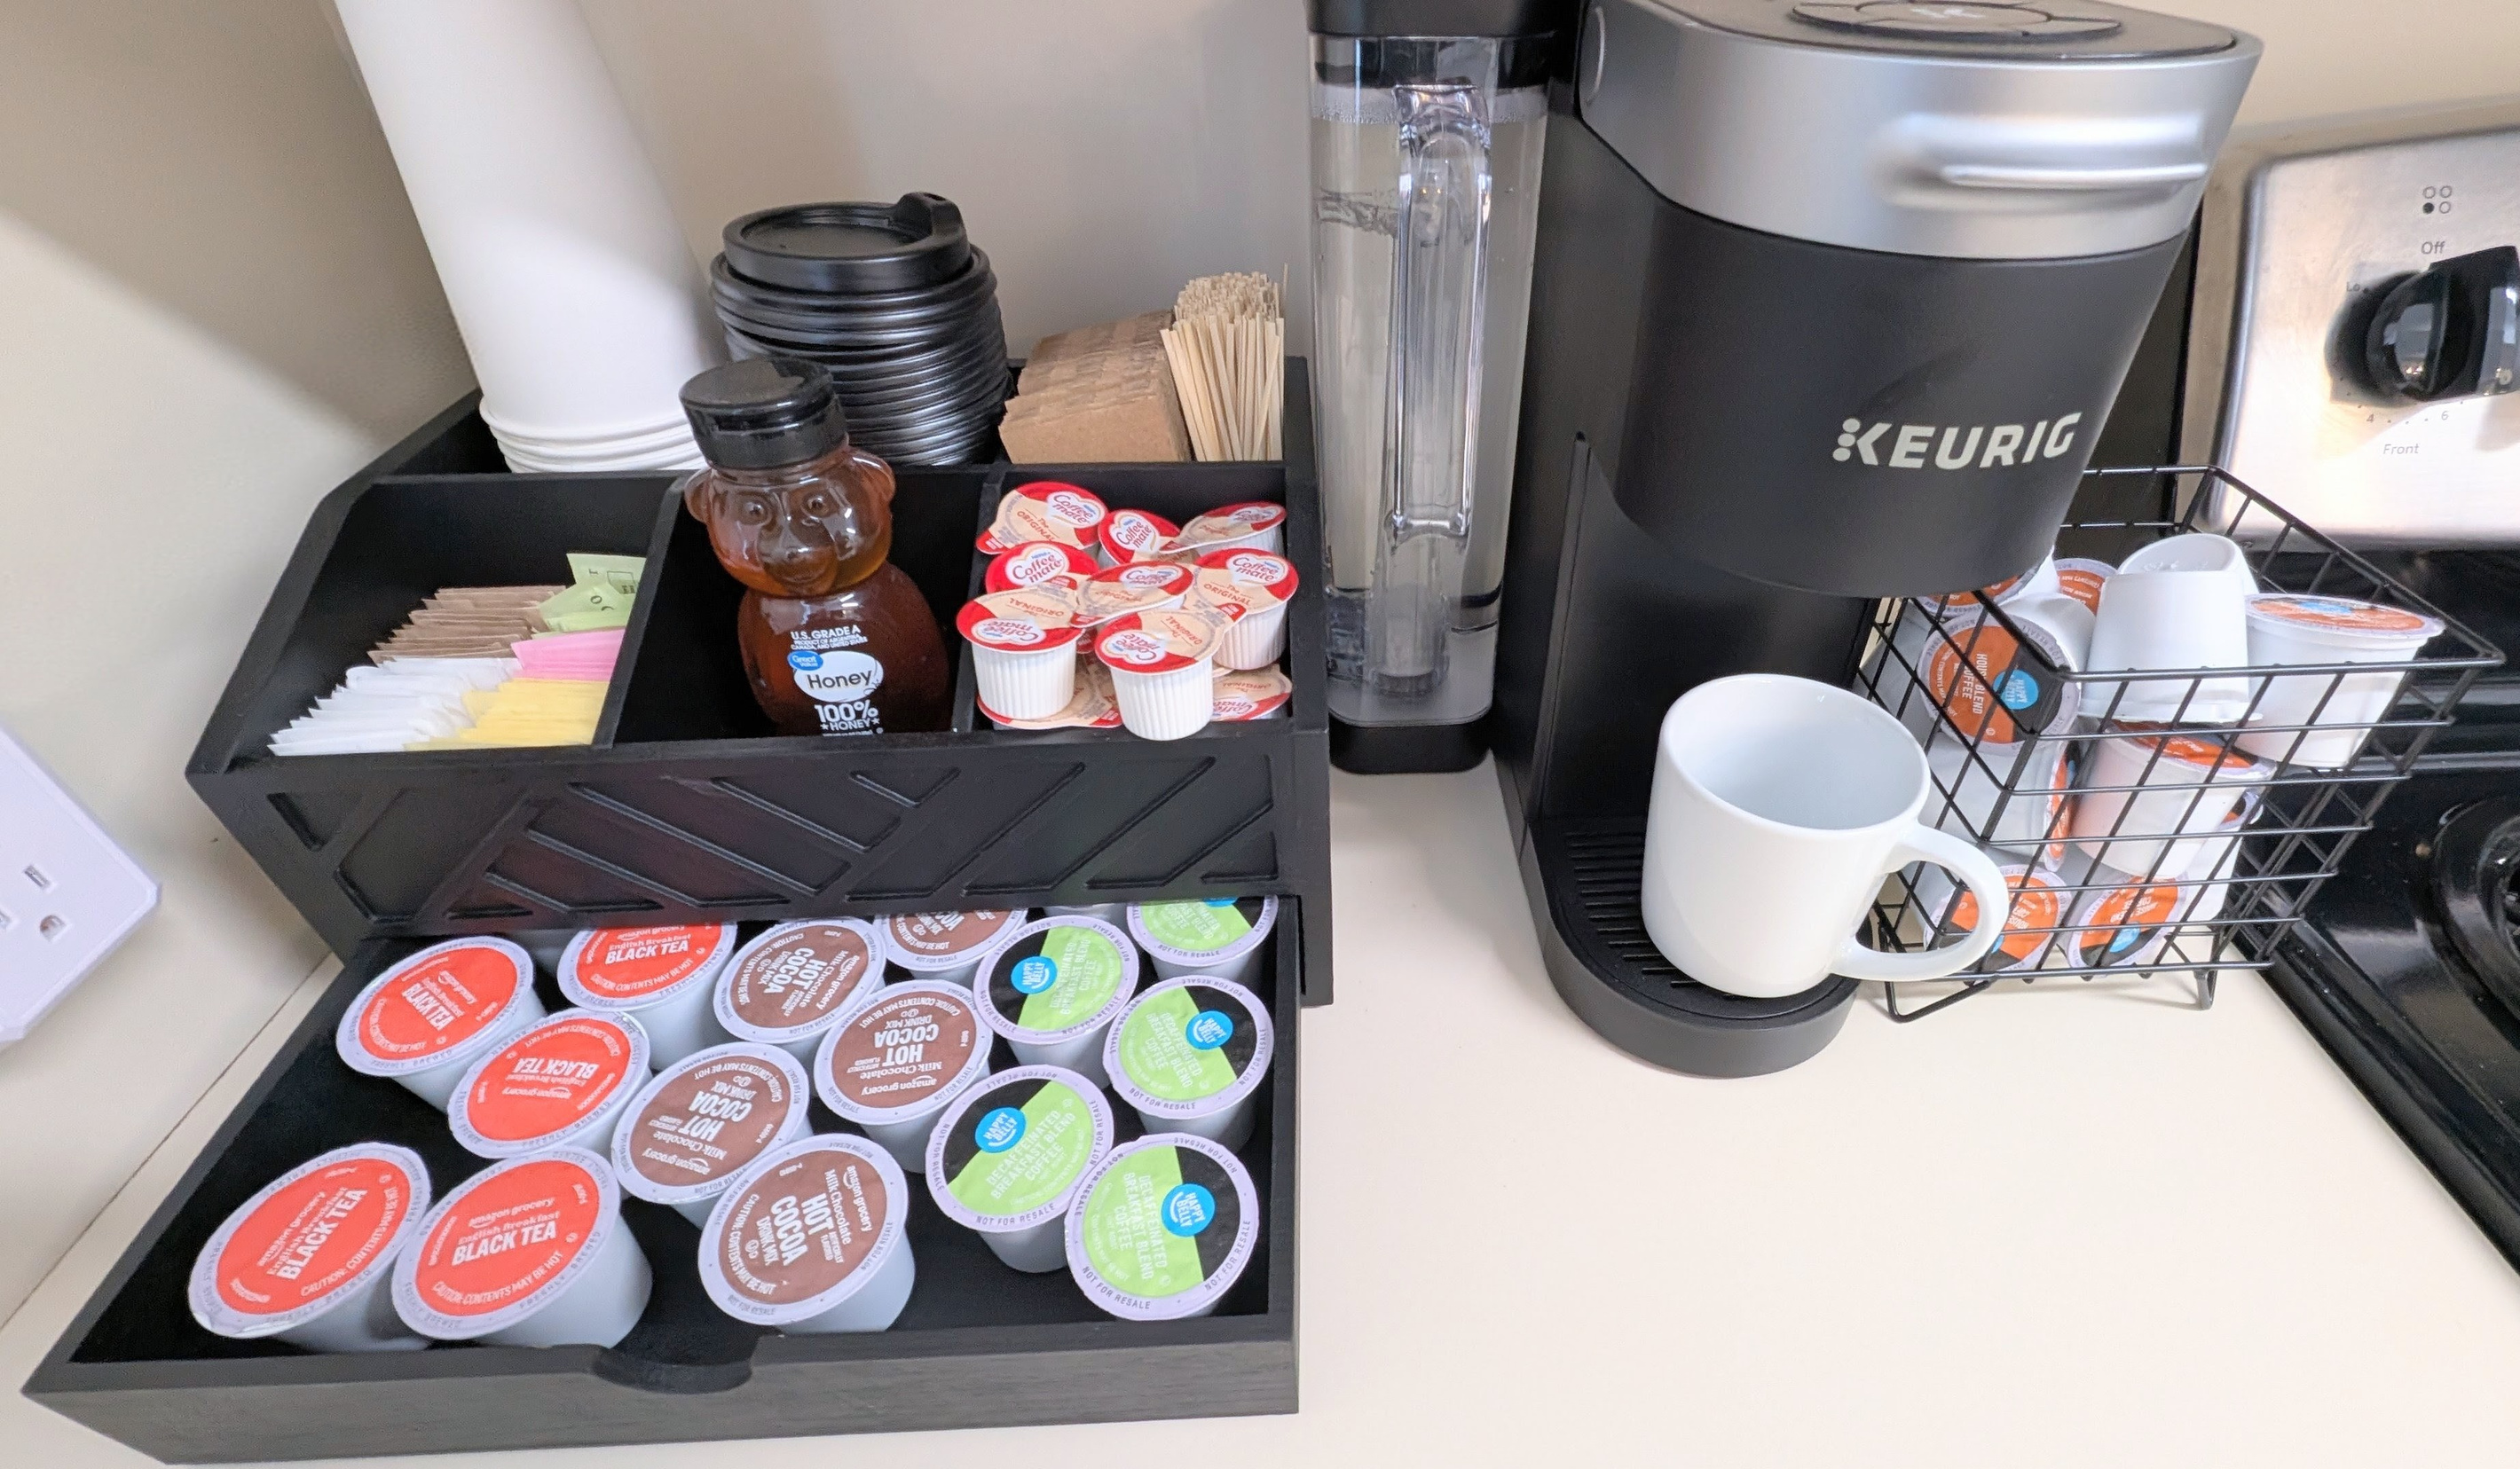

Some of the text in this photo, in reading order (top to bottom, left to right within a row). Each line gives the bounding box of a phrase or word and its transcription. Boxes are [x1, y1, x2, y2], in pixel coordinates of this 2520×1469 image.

[2421, 241, 2445, 255] Off
[2366, 411, 2449, 423] 4 6
[1832, 412, 2083, 469] KEURIG
[2382, 444, 2419, 455] Front
[1052, 504, 1087, 524] mate
[1053, 494, 1093, 519] Coffee
[1115, 521, 1145, 546] Coffee
[1133, 524, 1152, 548] mate
[1012, 554, 1055, 580] Coffee
[1028, 559, 1060, 584] mate
[1232, 556, 1279, 575] Coffee
[1235, 567, 1276, 581] mate
[1010, 598, 1064, 617] ORIGINAL
[1203, 584, 1251, 605] ORIGINAL
[811, 626, 850, 639] GRADE
[852, 625, 861, 633] A
[984, 626, 1038, 641] Coffee
[1166, 617, 1203, 645] ORIGINAL
[807, 671, 872, 688] Honey
[1973, 653, 1988, 715] HOUS BLEND
[815, 700, 878, 722] 100%
[830, 719, 870, 730] HONEY
[604, 945, 657, 964] BLACK
[661, 940, 689, 955] TEA
[608, 934, 692, 951] English Breakfast
[772, 932, 804, 949] CAUTION:
[758, 951, 791, 985] DRINK MIX
[763, 947, 815, 994] COCOA
[833, 950, 849, 966] Milk
[616, 959, 694, 991] CONTENTS MAY BE HOT
[792, 959, 828, 990] HOT
[799, 966, 834, 1008] Chocolate
[816, 955, 860, 1009] amazon grocery
[401, 982, 441, 1017] BLACK
[426, 1005, 456, 1032] TEA
[859, 997, 935, 1028] CONTENTS MAY BE HOT
[885, 1015, 933, 1029] DRINK MIX
[1198, 1025, 1217, 1044] BELLY
[1203, 1017, 1227, 1038] HAPPY
[874, 1024, 940, 1048] COCOA
[882, 1043, 923, 1067] HOT
[1146, 1013, 1178, 1057] BREAKFAST
[1169, 1057, 1193, 1088] BLEND
[1146, 1037, 1169, 1071] COFFEE
[512, 1057, 600, 1080] BLACK TEA
[694, 1067, 711, 1080] HOT
[860, 1062, 942, 1080] Milk Chocolate
[711, 1081, 757, 1101] DRINK MIX
[861, 1075, 937, 1096] amazon grocery
[689, 1090, 752, 1122] COCOA
[678, 1115, 725, 1142] HOT
[983, 1112, 1009, 1140] HAPPY
[992, 1117, 1018, 1142] BELLY
[1089, 1100, 1104, 1166] NOT FOR RESALE
[653, 1131, 728, 1160] Milk Chocolate
[986, 1110, 1061, 1186] DECAFFEINATED
[990, 1142, 1045, 1200] BREAKFAST
[1043, 1112, 1075, 1143] BLEND
[642, 1148, 711, 1175] amazon grocery
[1025, 1142, 1064, 1181] COFFEE
[290, 1191, 326, 1227] grocery
[511, 1198, 555, 1216] grocery
[731, 1193, 760, 1231] CAUTION:
[824, 1168, 852, 1245] Milk Chocolate
[843, 1166, 872, 1232] amazon grocery
[1185, 1192, 1206, 1222] HAPPY
[502, 1211, 561, 1232] Breakfast
[801, 1193, 834, 1235] HOT
[976, 1203, 1055, 1226] NOT FOR RESALE
[1123, 1172, 1154, 1279] BREAKFAST BLEND
[1176, 1199, 1193, 1227] BELLY
[277, 1220, 339, 1280] BLACK
[325, 1189, 368, 1219] TEA
[756, 1216, 779, 1266] DRINK MIX
[771, 1196, 807, 1267] COCOA
[1114, 1206, 1133, 1251] COFFEE
[451, 1230, 519, 1267] BLACK
[521, 1221, 556, 1247] TEA
[728, 1230, 742, 1271] CONTENTS
[1204, 1220, 1251, 1292] NOT FOR RESALE
[462, 1250, 564, 1305] CONTENTS MAY BE HOT
[735, 1266, 752, 1284] MAY
[1082, 1266, 1151, 1310] NOT FOR RESALE
